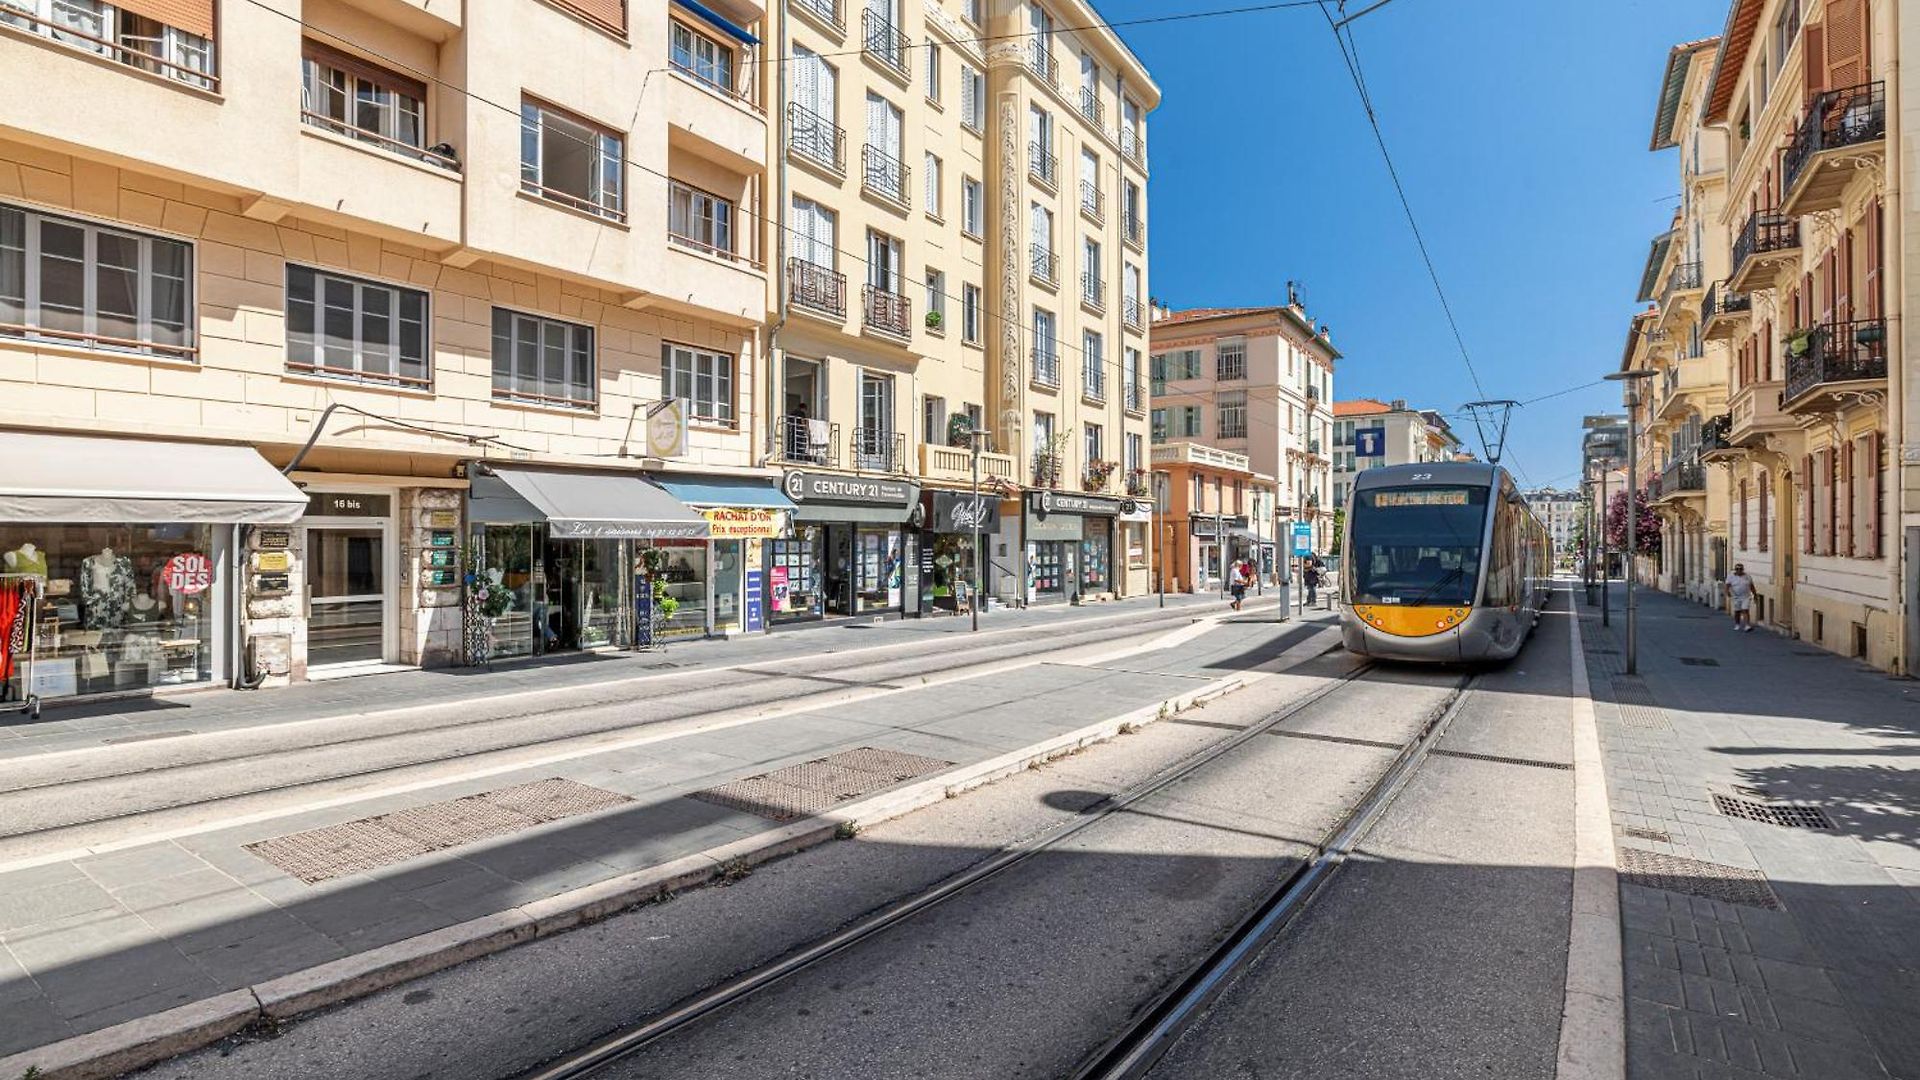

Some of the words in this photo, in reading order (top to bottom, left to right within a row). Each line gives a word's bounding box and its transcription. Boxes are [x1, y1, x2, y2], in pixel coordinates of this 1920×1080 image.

[1412, 472, 1433, 481] 23
[813, 480, 867, 496] CENTURY
[868, 484, 879, 497] 21
[333, 499, 345, 509] 16
[347, 499, 361, 509] bis
[713, 511, 747, 522] RACHAT
[712, 524, 726, 533] Prix
[172, 555, 208, 572] SOL
[171, 572, 209, 589] DES
